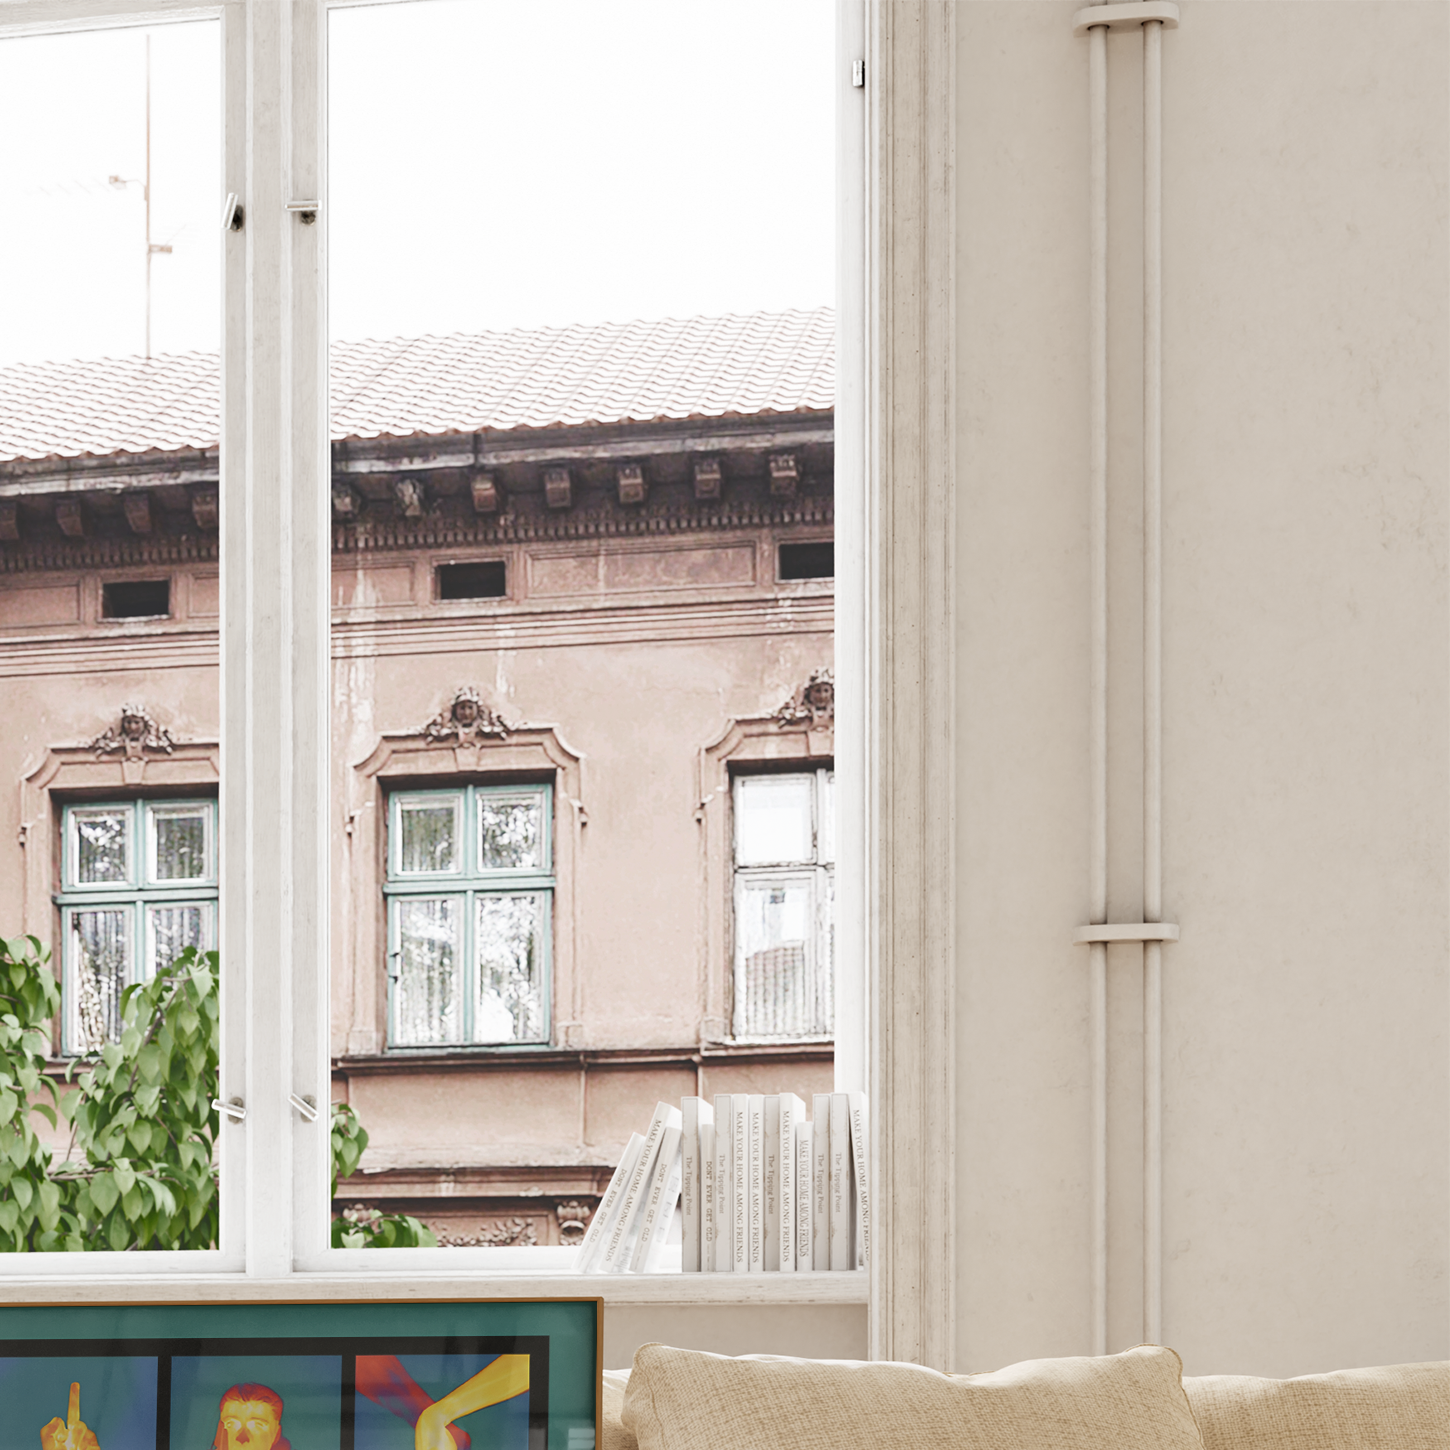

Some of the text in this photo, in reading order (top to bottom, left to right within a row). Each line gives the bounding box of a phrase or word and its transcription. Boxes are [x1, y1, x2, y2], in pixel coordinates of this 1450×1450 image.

[853, 1109, 861, 1134] MAKE
[855, 1134, 864, 1159] YOUR
[736, 1112, 744, 1263] MAKE YOUR HOME AMONG FRIENDS
[752, 1112, 760, 1263] MAKE YOUR HOME AMONG FRIENDS
[767, 1169, 775, 1197] Tipping
[782, 1111, 790, 1263] MAKE YOUR HOME AMONG FRIENDS
[816, 1168, 824, 1196] Tipping
[834, 1167, 842, 1195] Tipping
[857, 1160, 867, 1188] HOME
[605, 1190, 618, 1209] EVER
[606, 1119, 662, 1262] MAKE YOUR HOME AMONG FRIENDS
[650, 1186, 661, 1206] EVER
[799, 1140, 809, 1258] MAKE YOUR HOME AMONG FRIENDS
[597, 1212, 607, 1226] GET
[646, 1209, 655, 1224] GET
[860, 1188, 870, 1224] AMONG
[590, 1228, 599, 1243] OLD
[641, 1227, 650, 1242] OLD
